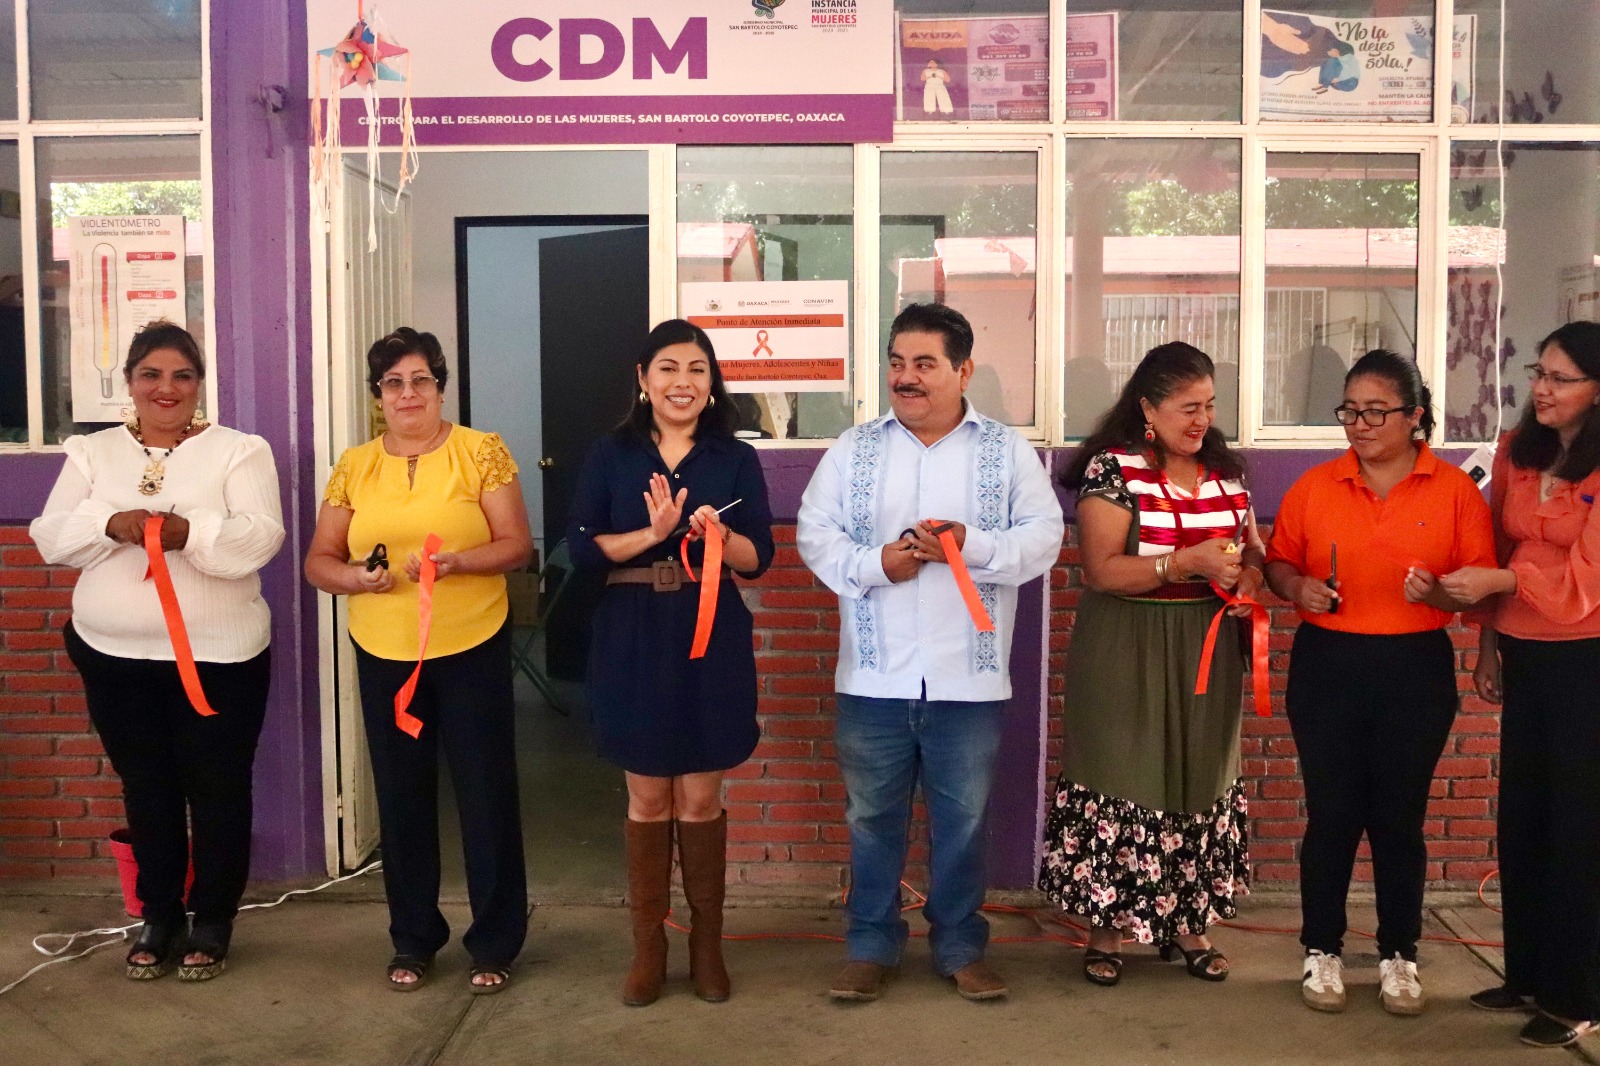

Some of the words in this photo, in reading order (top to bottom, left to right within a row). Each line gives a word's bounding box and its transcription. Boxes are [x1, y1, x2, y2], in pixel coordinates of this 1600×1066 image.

[812, 14, 857, 24] MUJERES
[1371, 26, 1389, 40] la
[491, 17, 708, 82] CDM
[1358, 40, 1395, 56] dejes
[405, 116, 438, 125] ARA
[441, 115, 455, 124] EL
[458, 115, 533, 124] DESARROLLO
[536, 114, 552, 124] DE
[555, 114, 577, 124] LAS
[580, 114, 636, 124] MUJERES,
[638, 114, 662, 124] SAN
[665, 114, 720, 123] BARTOLO
[722, 113, 794, 124] COYOTEPEC,
[796, 113, 845, 122] OAXACA
[80, 218, 161, 228] VIOLENTÓMETRO
[730, 361, 760, 369] Mujeres,
